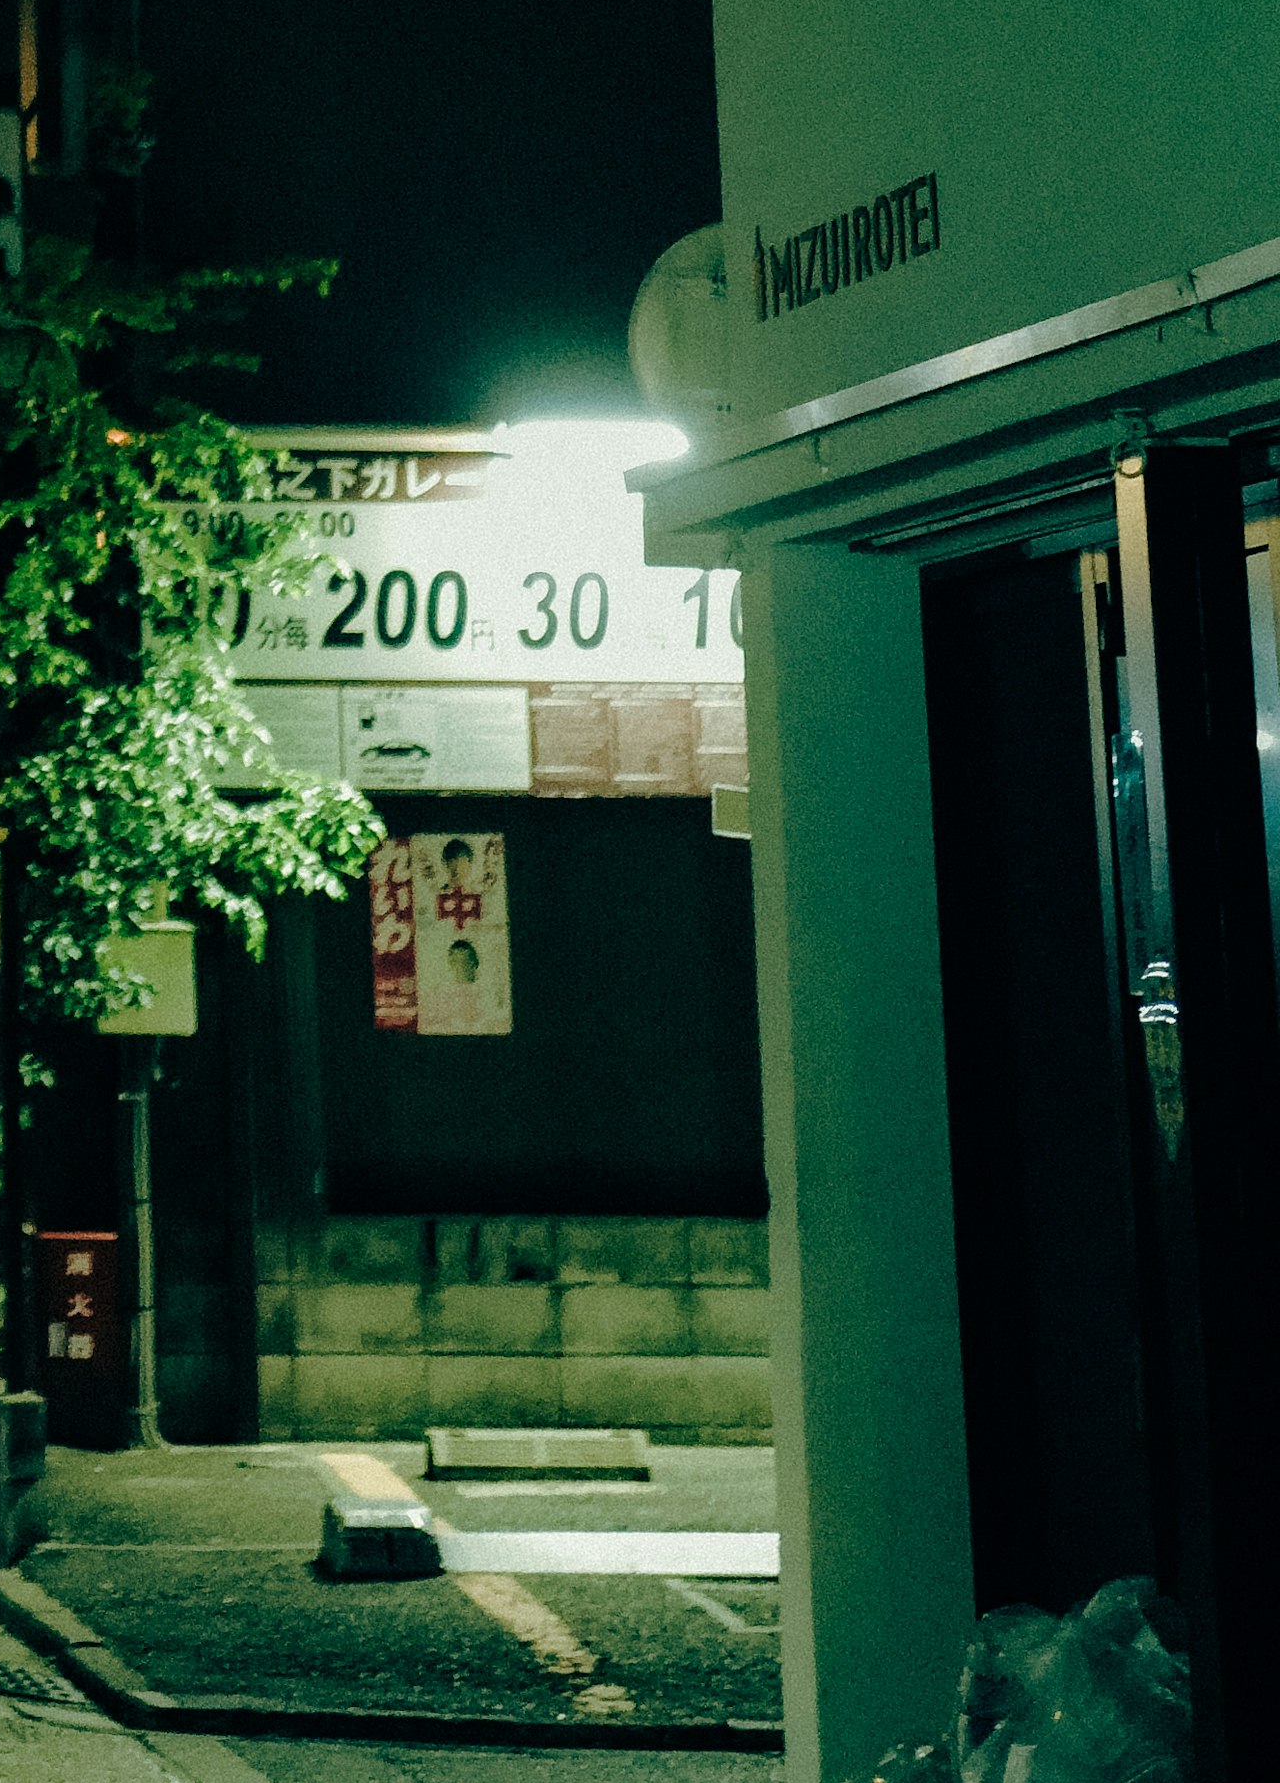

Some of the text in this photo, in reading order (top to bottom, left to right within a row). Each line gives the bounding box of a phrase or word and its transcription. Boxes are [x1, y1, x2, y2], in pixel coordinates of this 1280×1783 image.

[769, 170, 940, 318] MIZUIROTEI
[321, 569, 468, 651] 200
[517, 571, 610, 651] 30
